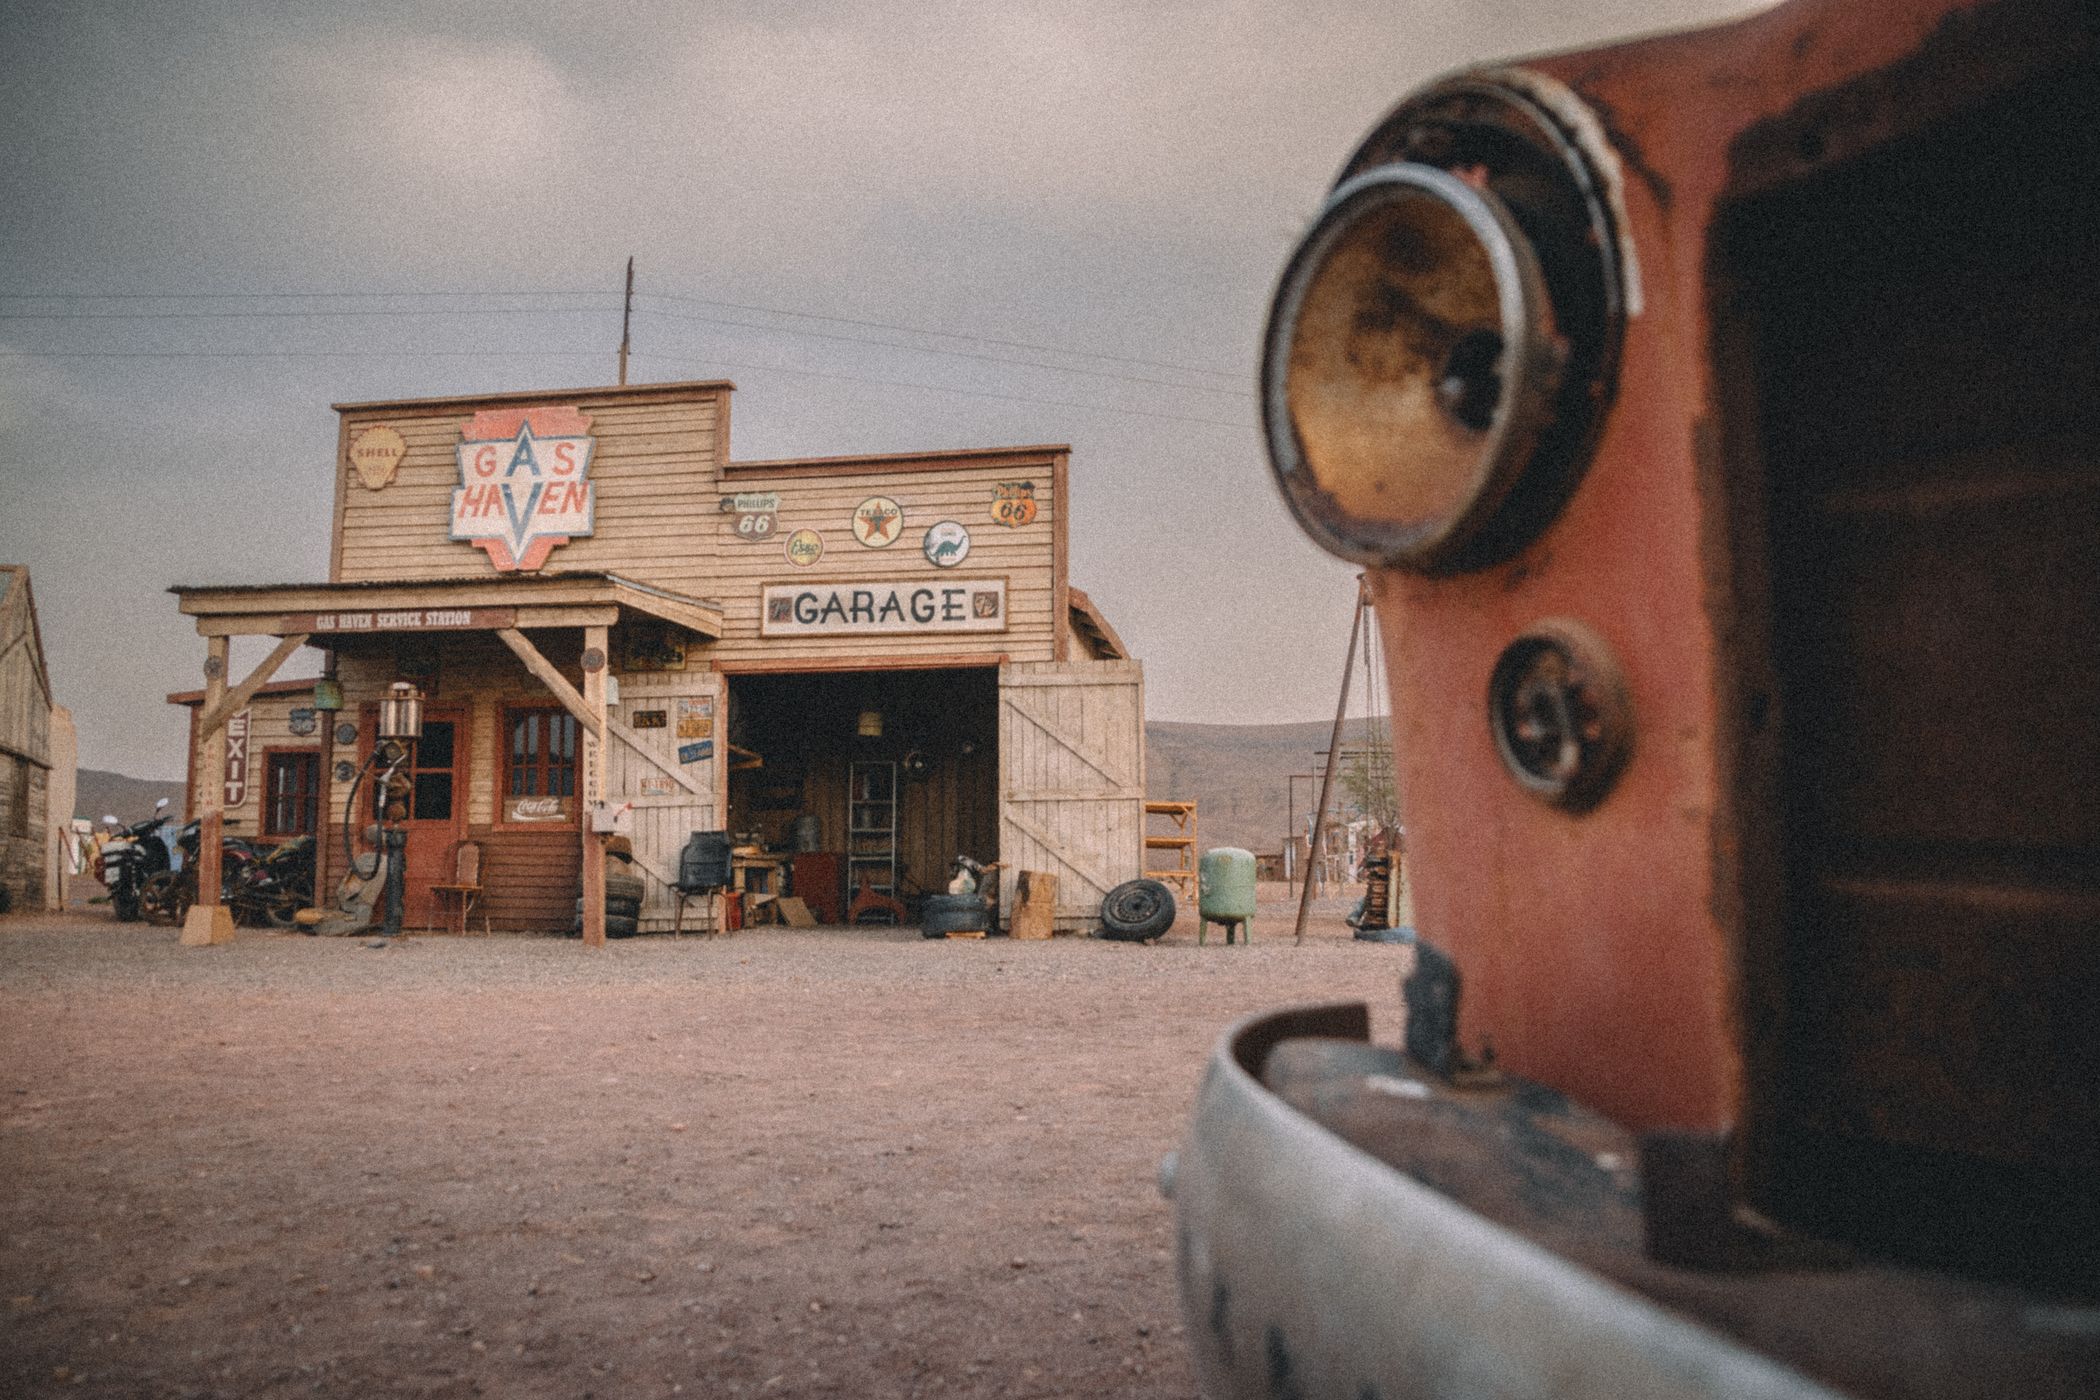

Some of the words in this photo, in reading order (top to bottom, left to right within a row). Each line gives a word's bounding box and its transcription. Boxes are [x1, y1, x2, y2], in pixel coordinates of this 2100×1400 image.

[357, 448, 398, 457] SHELL
[474, 434, 576, 478] GAS
[458, 480, 589, 541] HAVEN
[737, 498, 776, 509] PHILLIPS
[1001, 501, 1028, 520] 66
[739, 514, 771, 533] 66
[794, 588, 966, 624] GARAGE
[316, 615, 336, 629] GAS
[339, 613, 373, 628] HAVEN
[377, 612, 422, 627] SERVICE
[426, 610, 471, 626] STATION
[225, 718, 246, 801] EXIT
